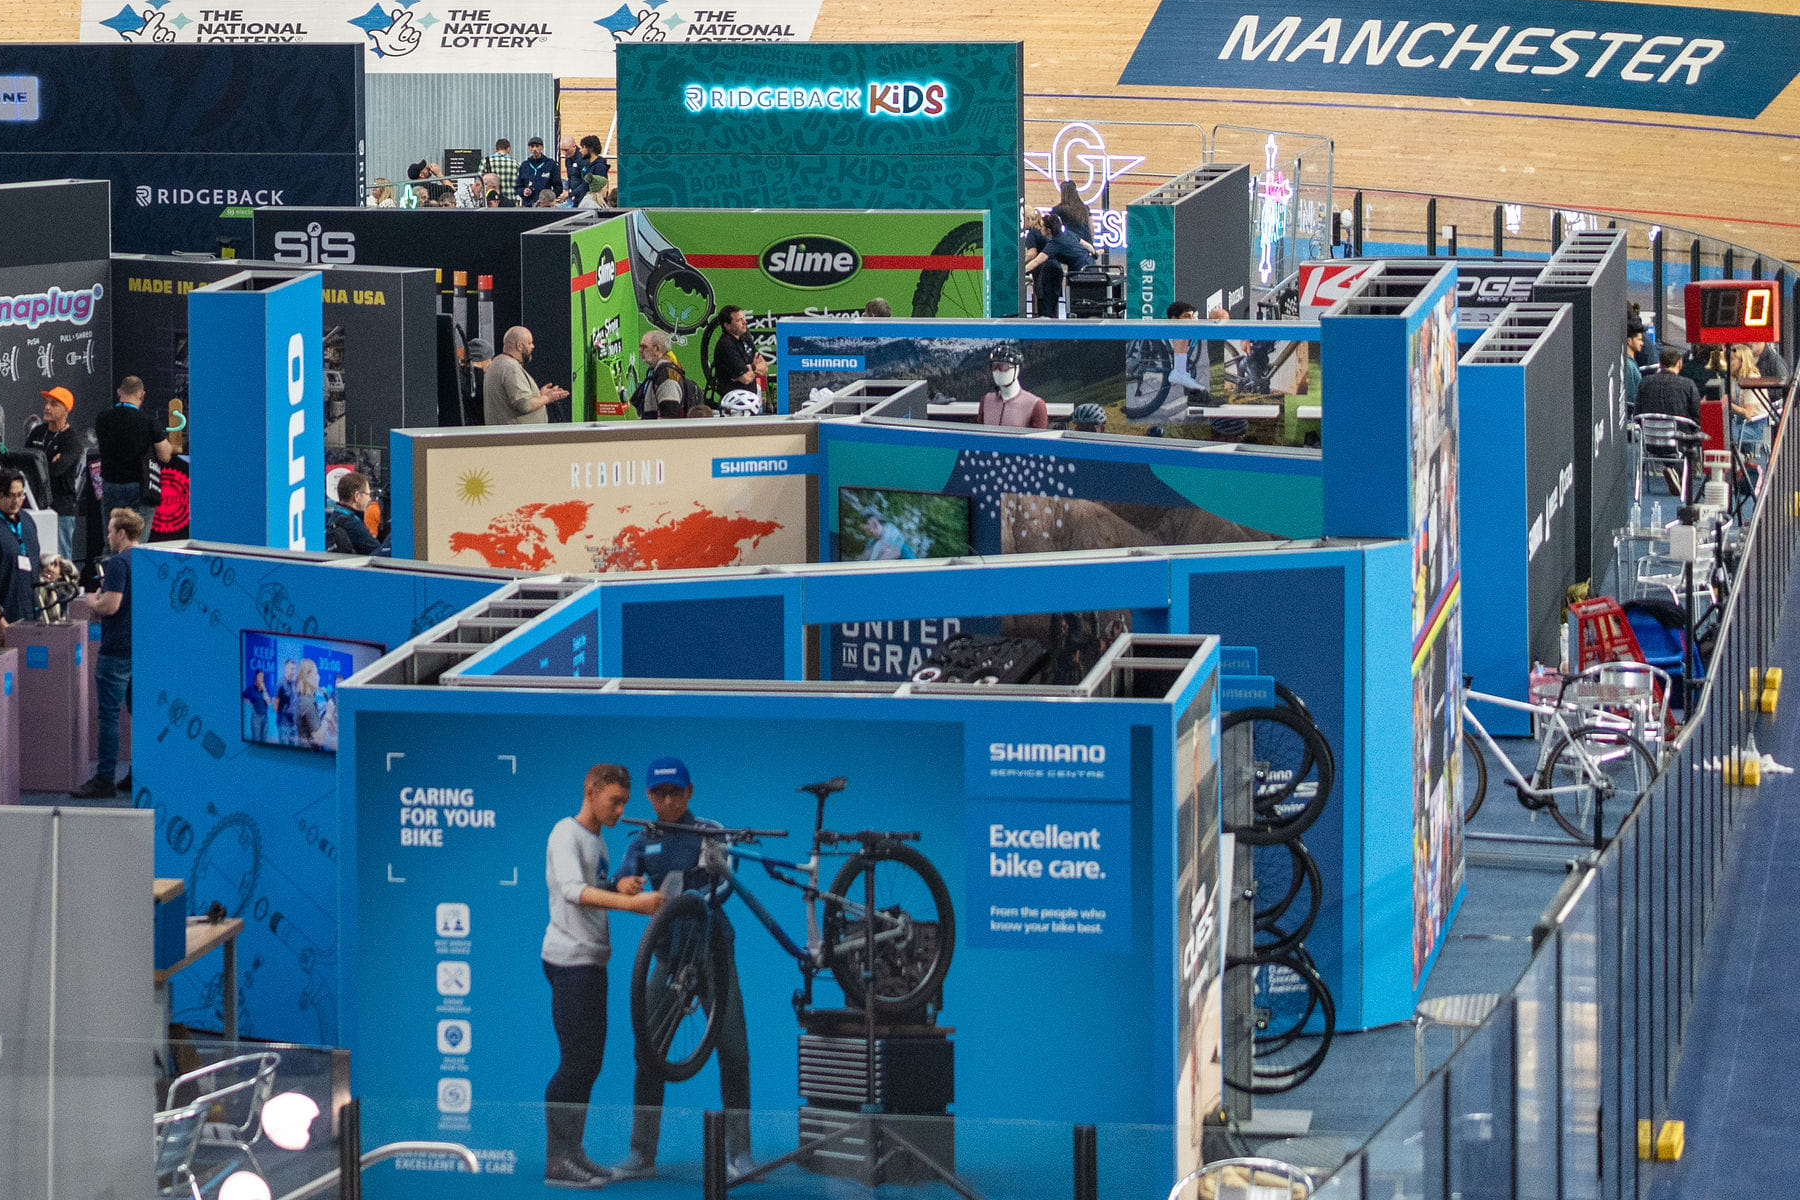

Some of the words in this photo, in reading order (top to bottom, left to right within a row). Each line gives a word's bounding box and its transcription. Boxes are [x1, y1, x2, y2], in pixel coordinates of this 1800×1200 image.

[200, 9, 244, 22] THE
[448, 9, 490, 22] THE
[695, 10, 737, 23] THE
[197, 22, 307, 37] NATIONAL
[443, 22, 552, 36] NATIONAL
[690, 22, 795, 37] NATIONAL
[1219, 14, 1725, 86] MANCHESTER
[710, 89, 861, 109] RIDGEBACK
[157, 188, 284, 205] RIDGEBACK
[769, 244, 854, 271] slime
[597, 256, 616, 286] slime
[128, 277, 172, 294] MADE
[177, 281, 194, 294] IN
[353, 291, 386, 305] USA
[801, 357, 858, 368] SHIMANO
[571, 459, 665, 489] REBOUND
[720, 459, 788, 475] SHIMANO
[989, 742, 1106, 764] SHIMANO
[990, 769, 1043, 778] SERVICE
[1047, 769, 1105, 779] CENTRE
[400, 787, 474, 807] CARING
[400, 807, 439, 827] FOR
[443, 808, 496, 828] YOUR
[400, 828, 443, 847] BIKE
[989, 824, 1101, 850] Excellent
[990, 852, 1043, 878] bike
[1048, 859, 1106, 879] care.
[990, 905, 1018, 917] From
[1020, 906, 1038, 917] the
[1041, 907, 1078, 921] people
[1080, 907, 1106, 919] who
[990, 920, 1022, 932] know
[1024, 922, 1049, 935] your
[1051, 920, 1075, 933] bike
